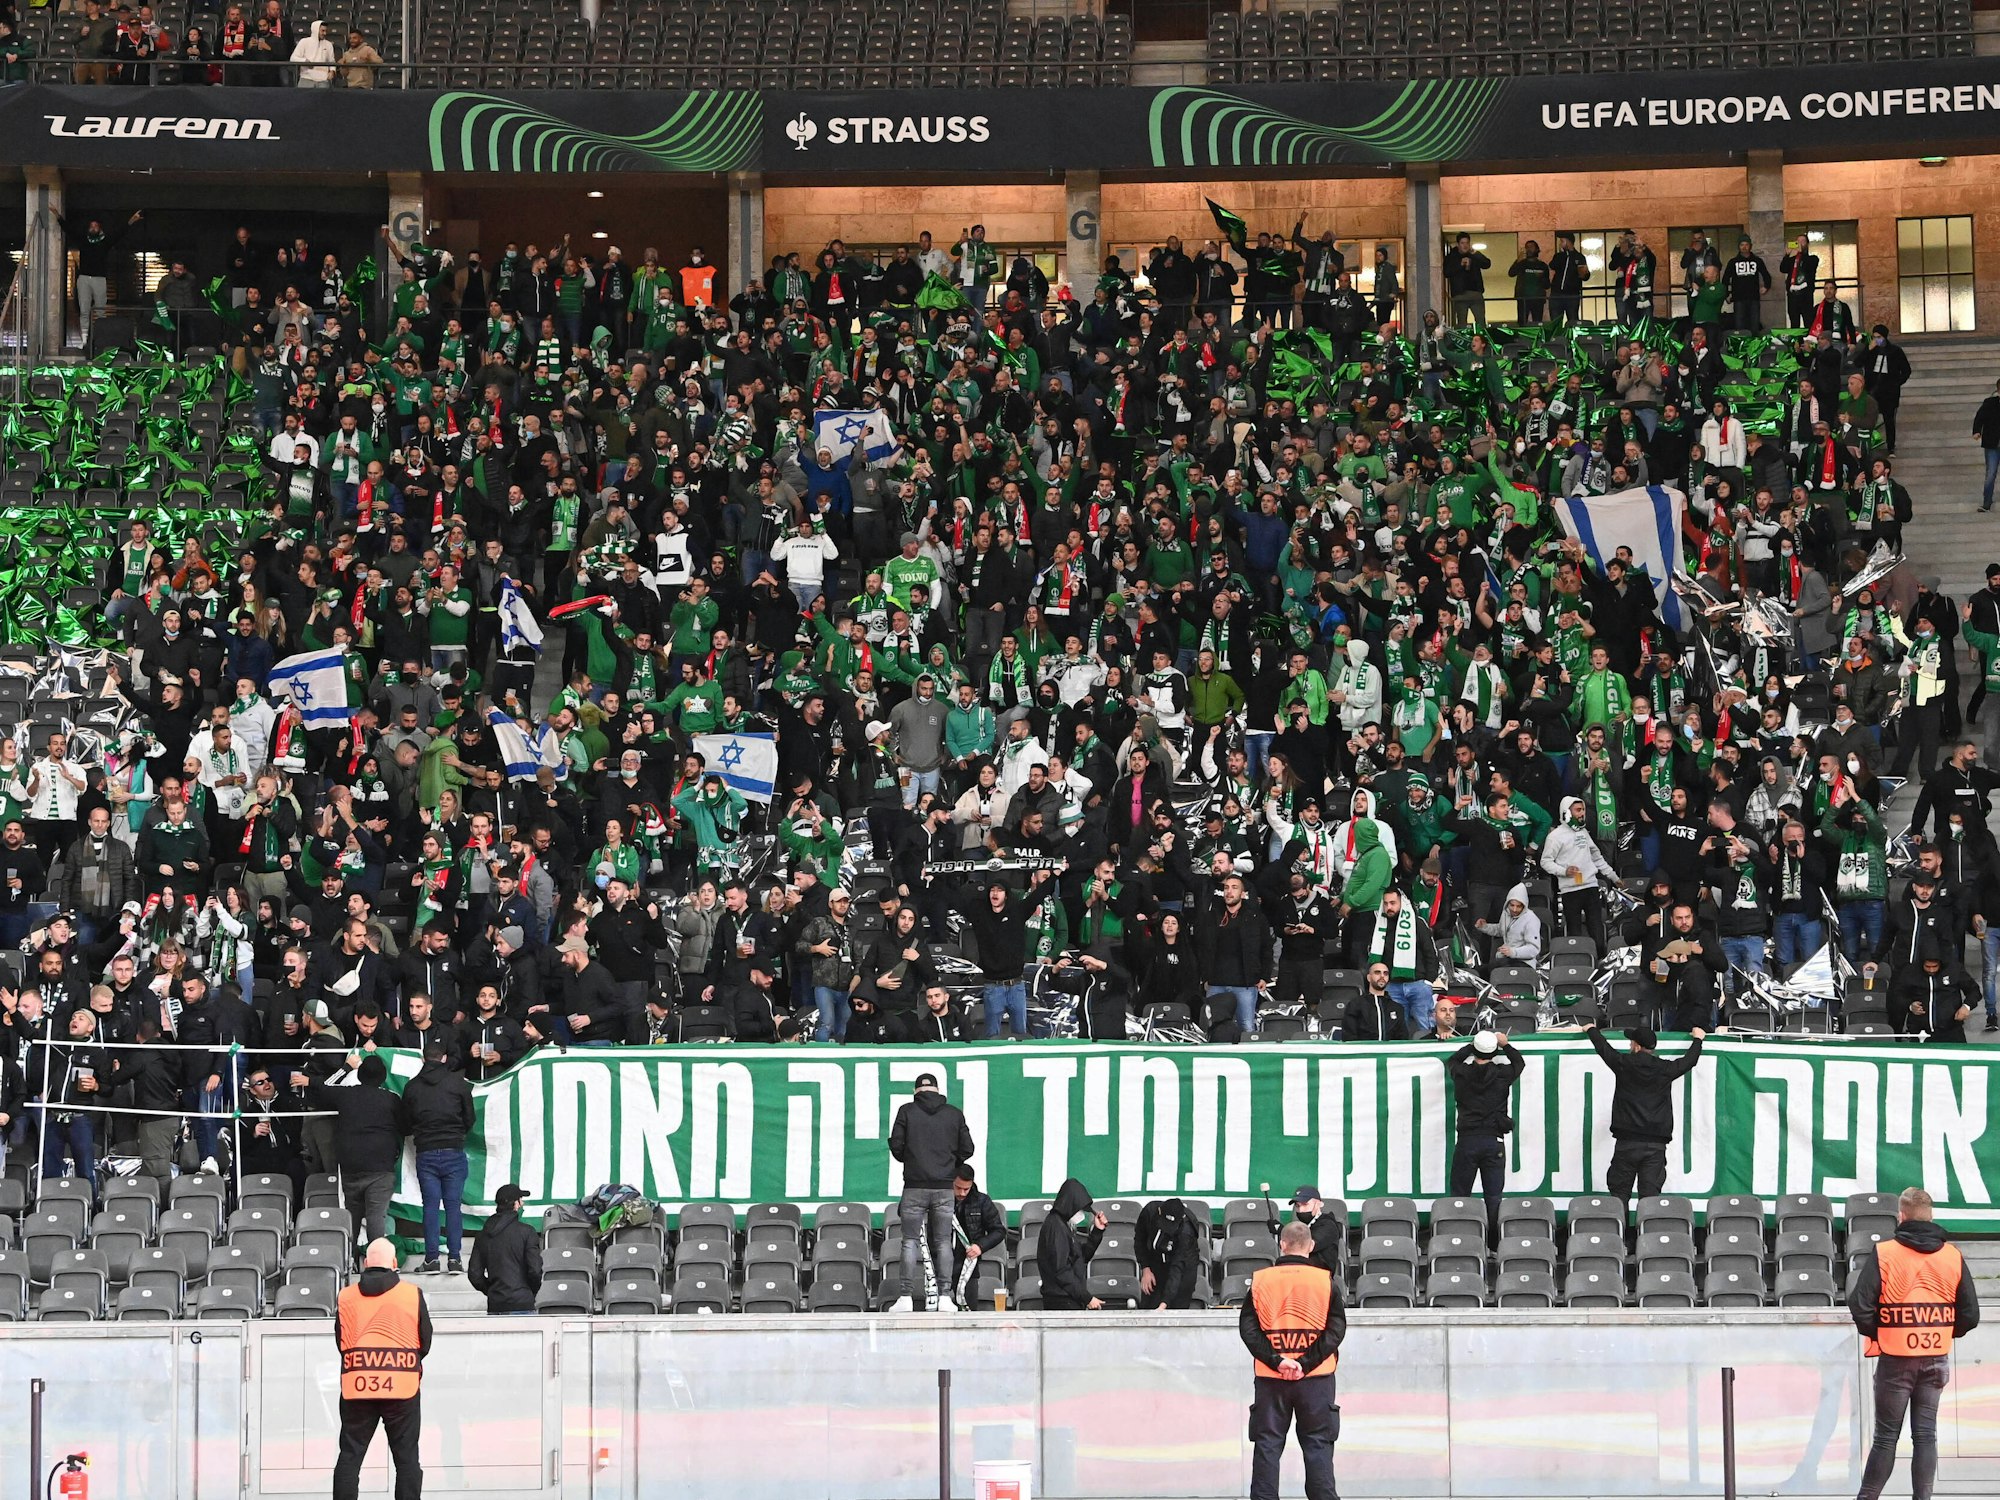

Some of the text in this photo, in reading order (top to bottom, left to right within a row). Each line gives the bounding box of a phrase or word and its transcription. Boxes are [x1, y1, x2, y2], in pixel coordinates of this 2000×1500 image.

[1648, 95, 1792, 126] EUROPA
[1801, 84, 2000, 120] CONFEREN
[827, 115, 990, 143] STRAUSS
[392, 211, 420, 242] G
[1070, 210, 1097, 241] G
[1735, 261, 1757, 273] 1913
[897, 572, 929, 584] VOLVO
[1668, 823, 1698, 841] VANS
[931, 860, 975, 873] חיפה
[1396, 910, 1412, 950] 2019
[1023, 1055, 1252, 1193] תמיד
[1752, 1057, 1992, 1204] איפה
[190, 1332, 202, 1345] G
[1267, 1332, 1320, 1350] EWAR
[1906, 1332, 1942, 1350] 032
[344, 1350, 417, 1370] STEWARD
[354, 1375, 394, 1392] 034
